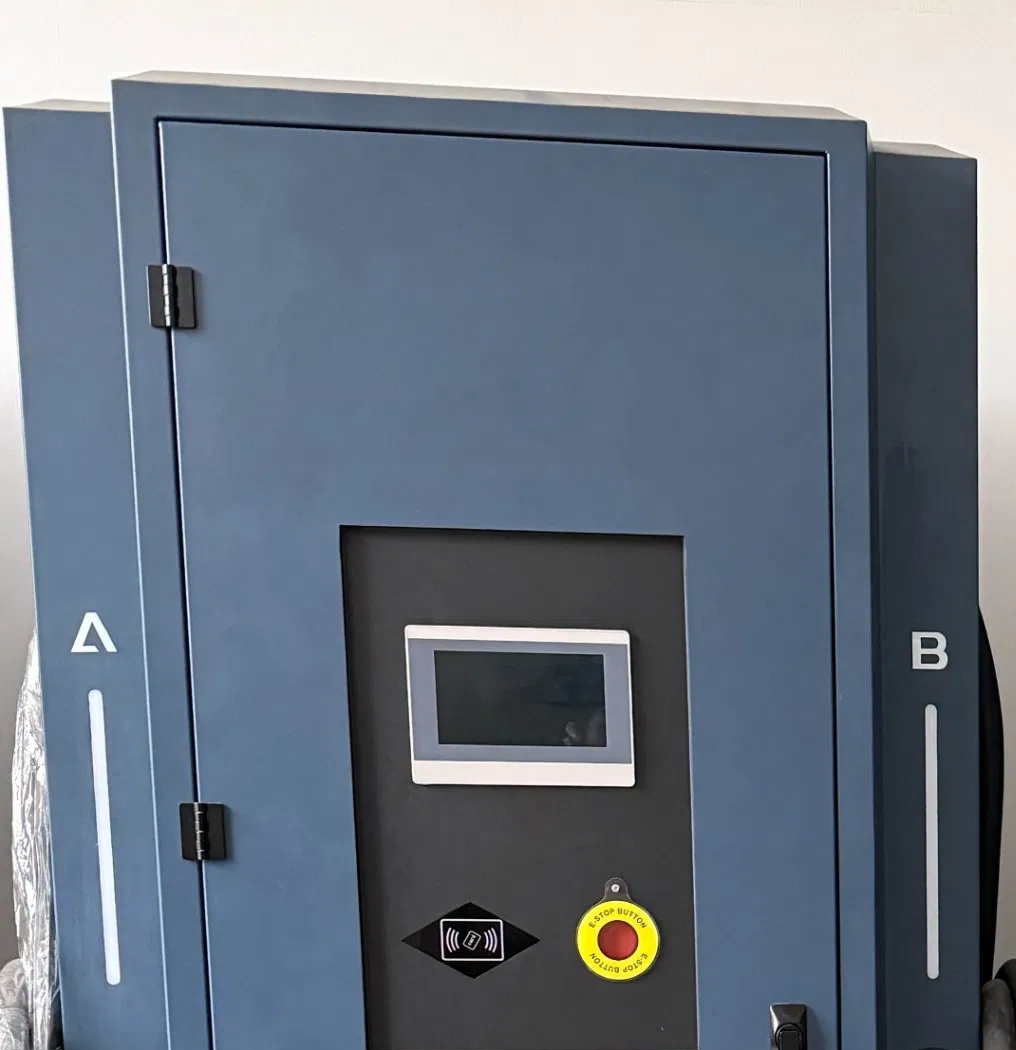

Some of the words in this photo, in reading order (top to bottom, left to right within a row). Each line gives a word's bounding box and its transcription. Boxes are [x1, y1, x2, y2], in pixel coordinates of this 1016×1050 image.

[71, 611, 118, 653] A
[911, 631, 948, 670] B
[588, 908, 615, 928] E-STOP
[617, 908, 648, 928] BUTTON
[589, 953, 620, 973] BUTTON
[622, 953, 649, 973] E-STOP
